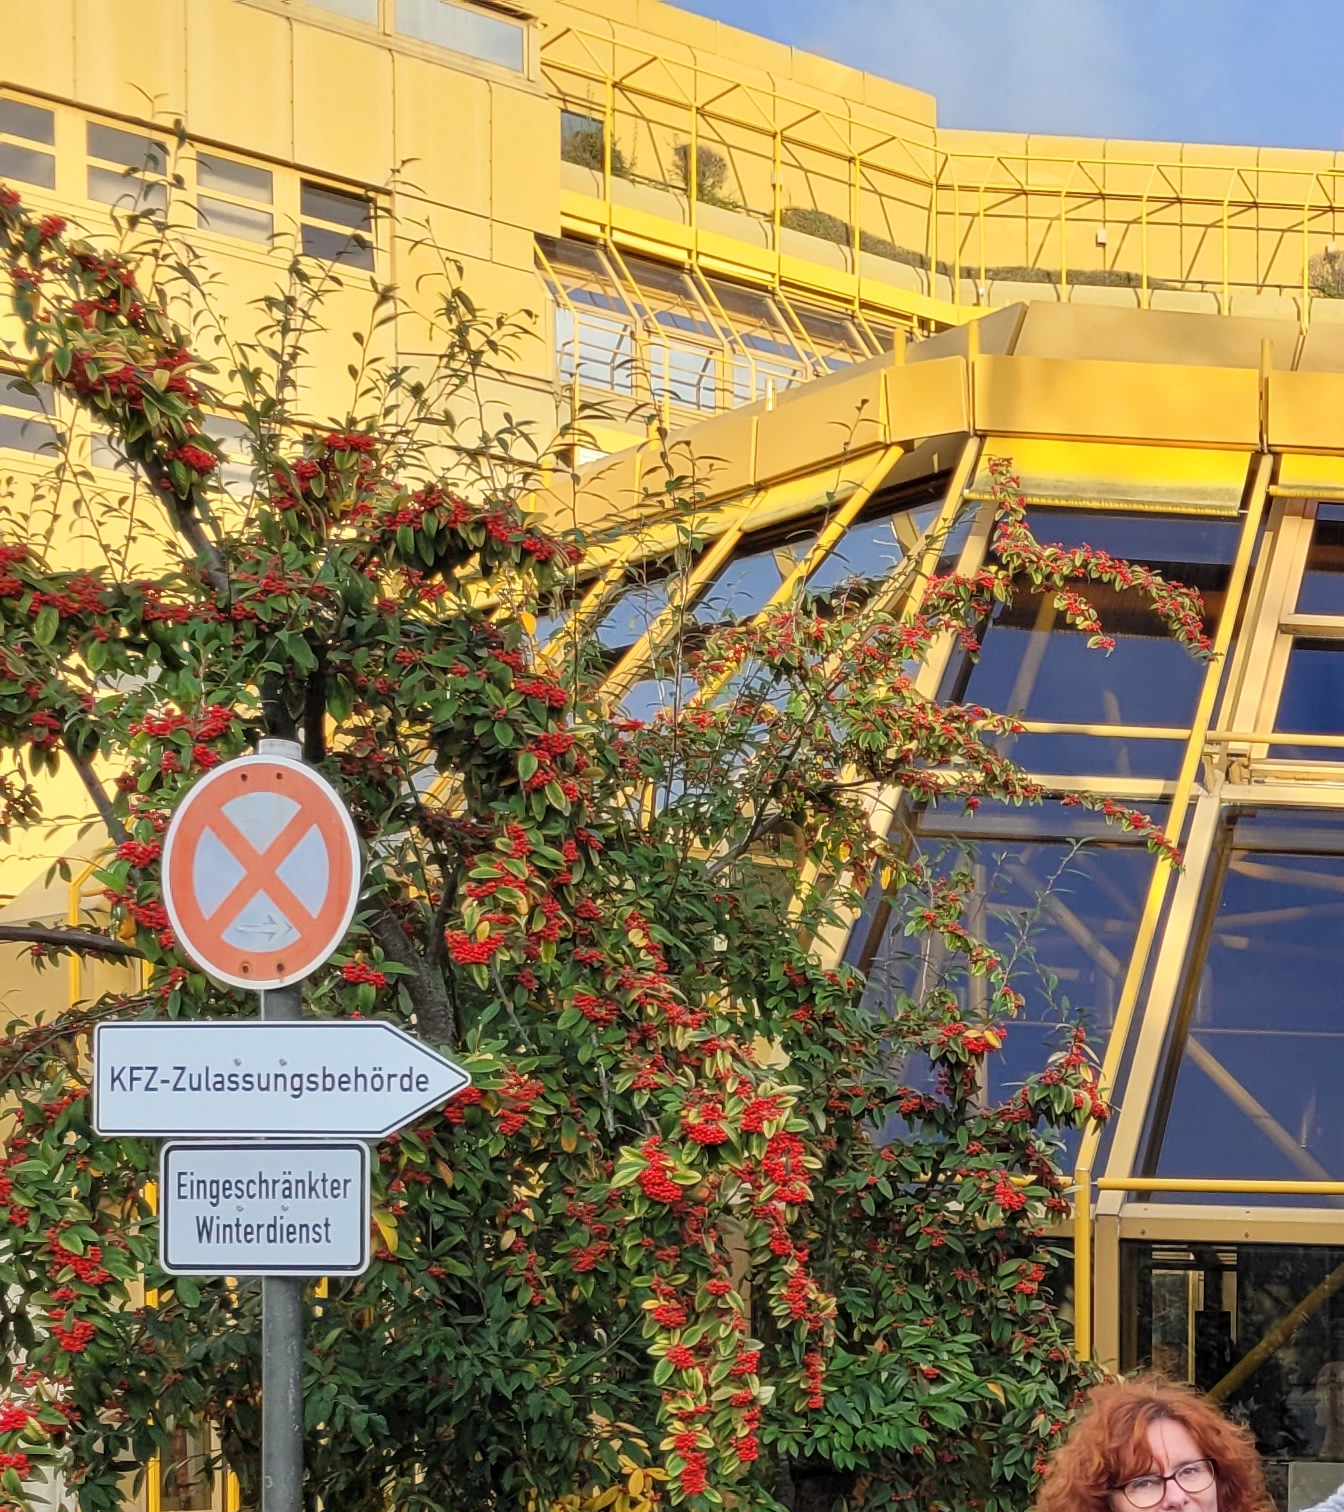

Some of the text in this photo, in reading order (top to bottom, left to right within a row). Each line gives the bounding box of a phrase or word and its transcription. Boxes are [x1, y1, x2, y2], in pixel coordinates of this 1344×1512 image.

[109, 1064, 431, 1099] KFZ-Zulassungsbehörde
[176, 1170, 353, 1208] Eingeschränkter
[195, 1214, 333, 1246] Winterdienst
